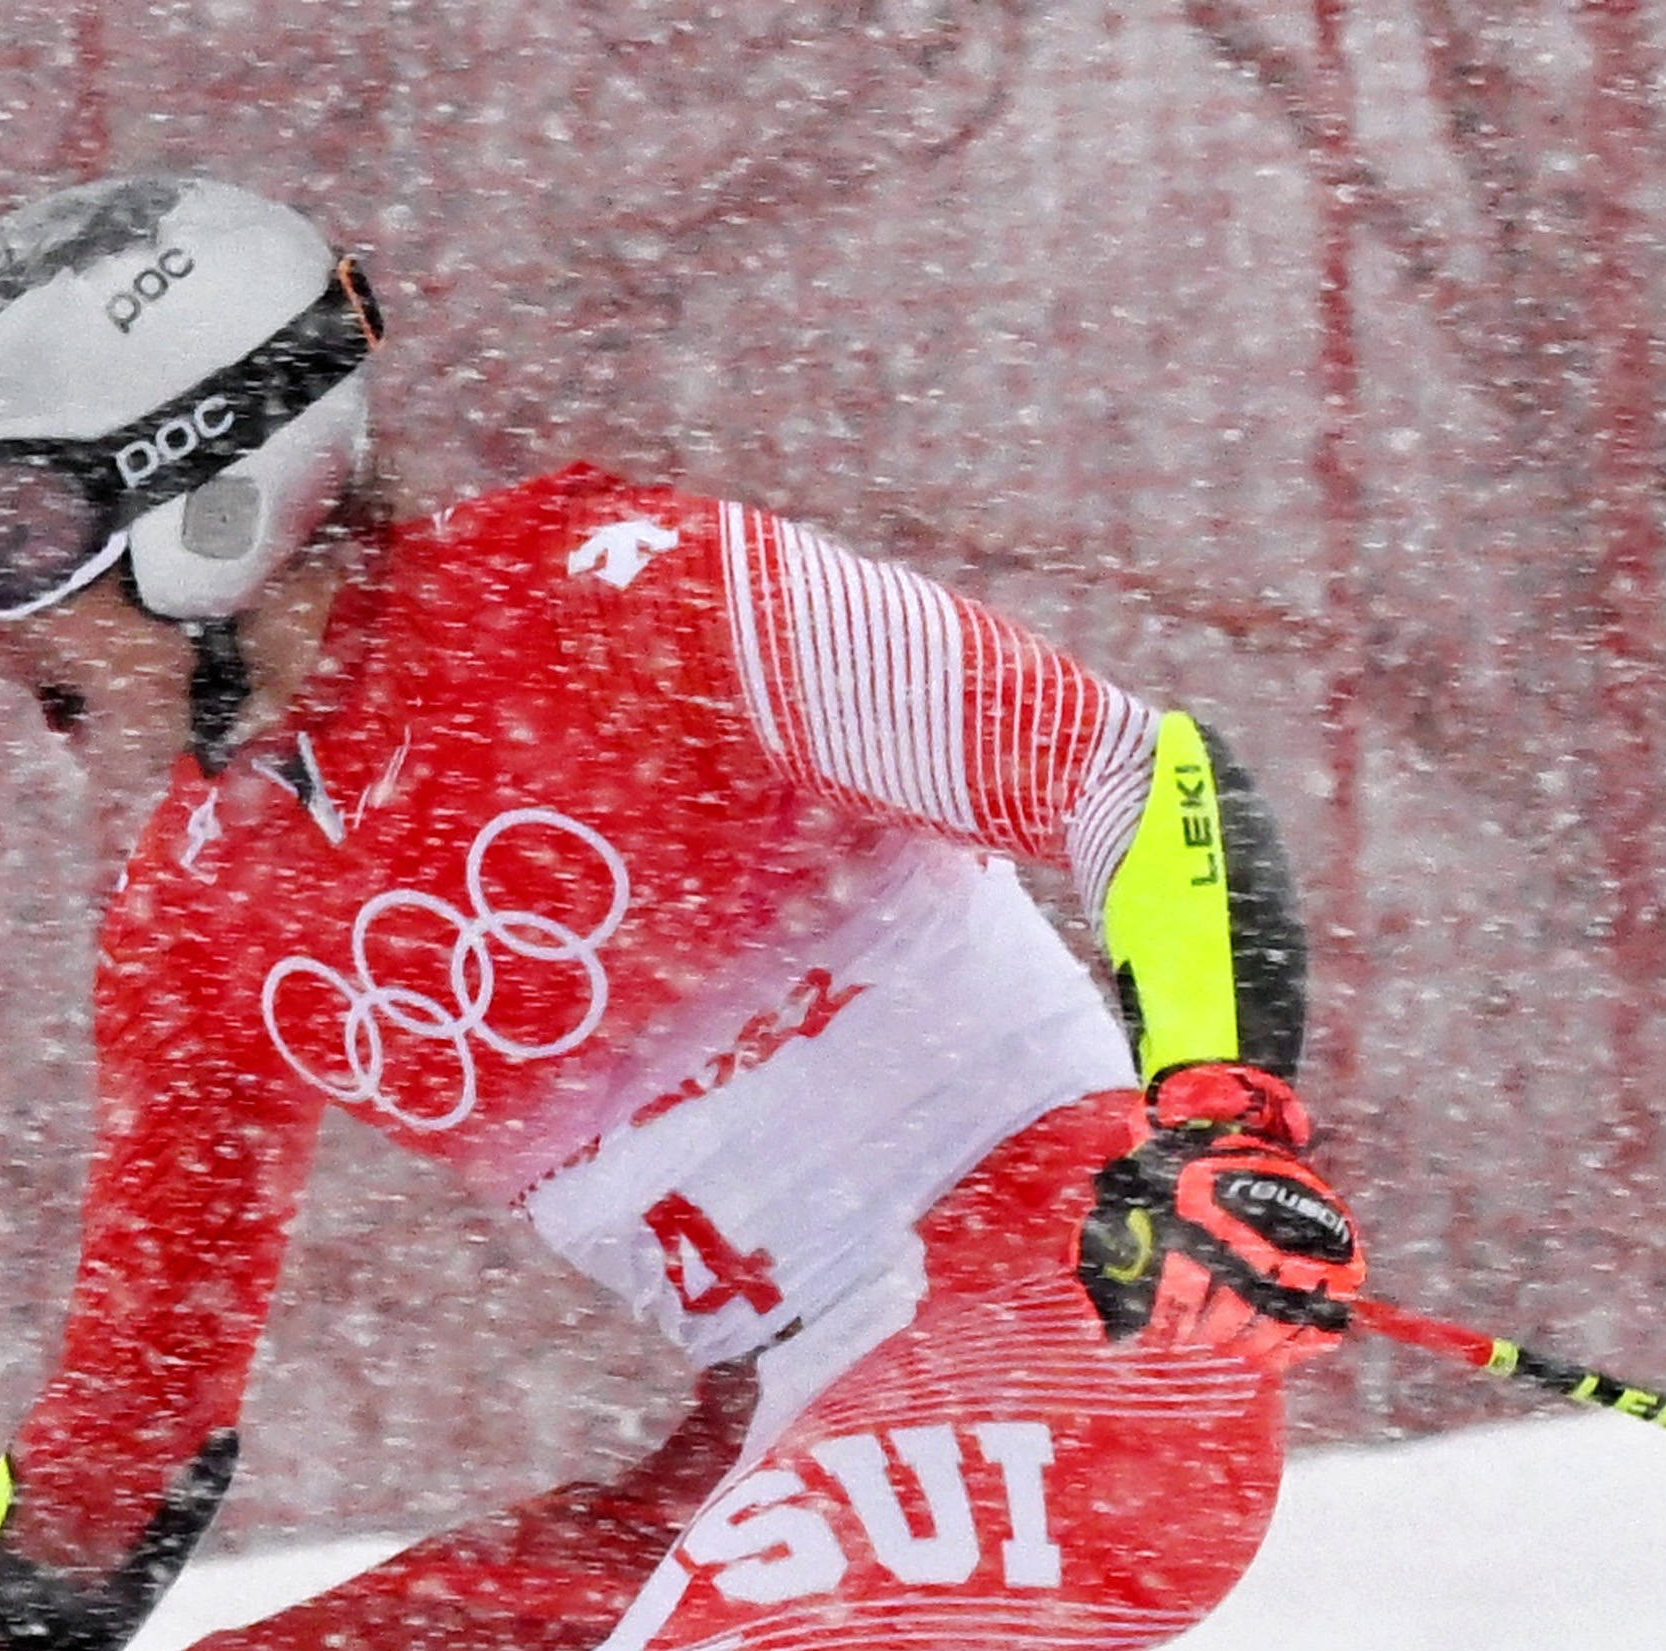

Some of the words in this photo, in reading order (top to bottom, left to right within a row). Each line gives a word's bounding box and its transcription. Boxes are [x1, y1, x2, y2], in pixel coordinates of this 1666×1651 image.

[1174, 765, 1218, 887] LEKI
[643, 1191, 784, 1316] 4
[683, 1422, 1063, 1605] SUI
